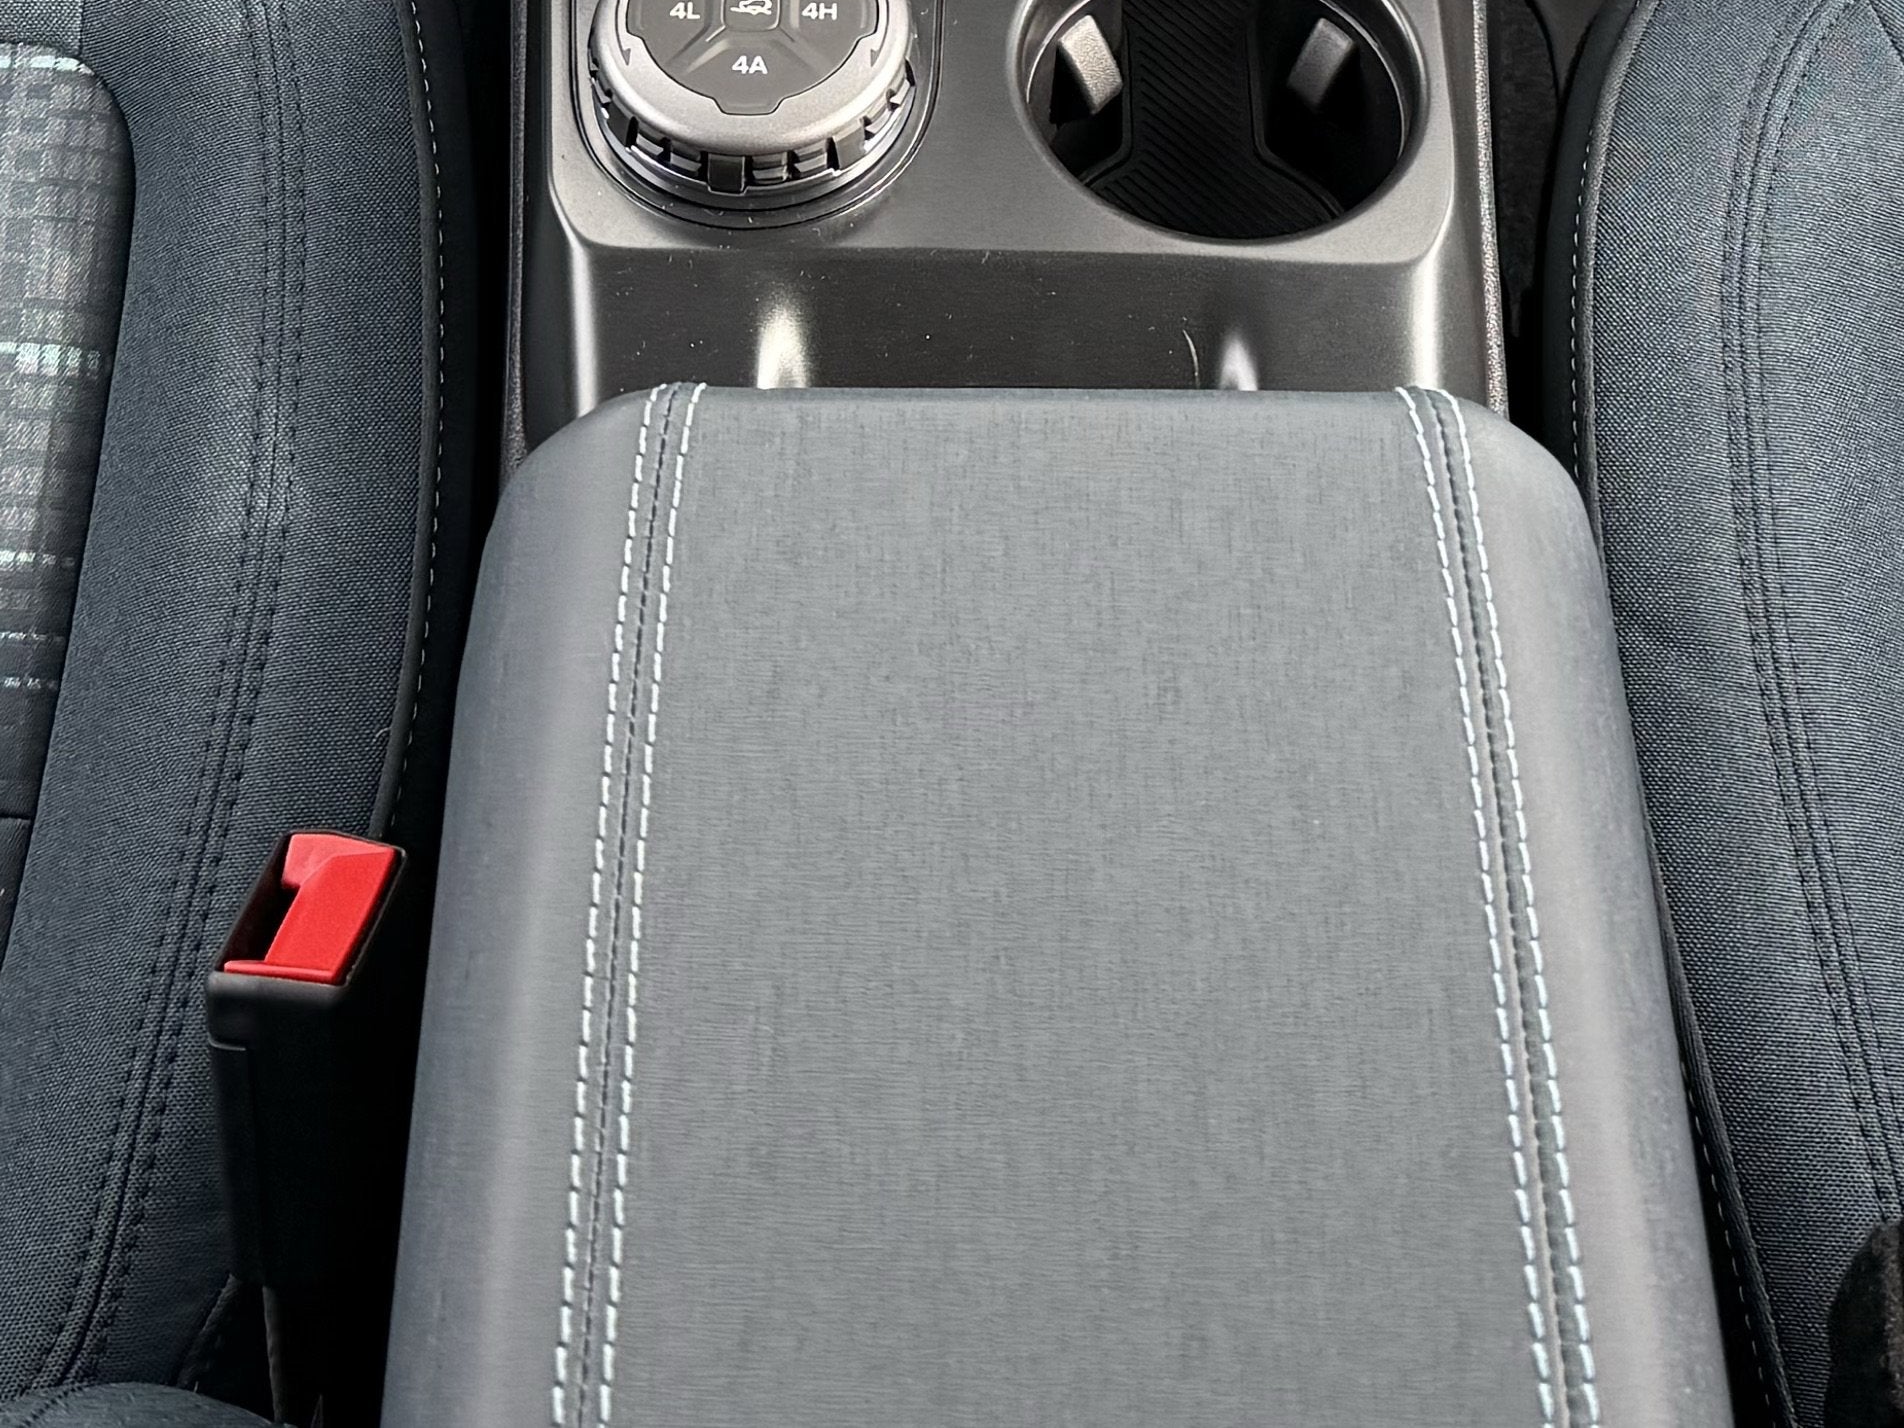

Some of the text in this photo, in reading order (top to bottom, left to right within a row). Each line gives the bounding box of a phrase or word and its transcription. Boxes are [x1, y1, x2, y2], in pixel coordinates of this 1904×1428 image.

[669, 3, 701, 20] 4L
[801, 3, 838, 20] 4H
[731, 55, 769, 75] 4A
